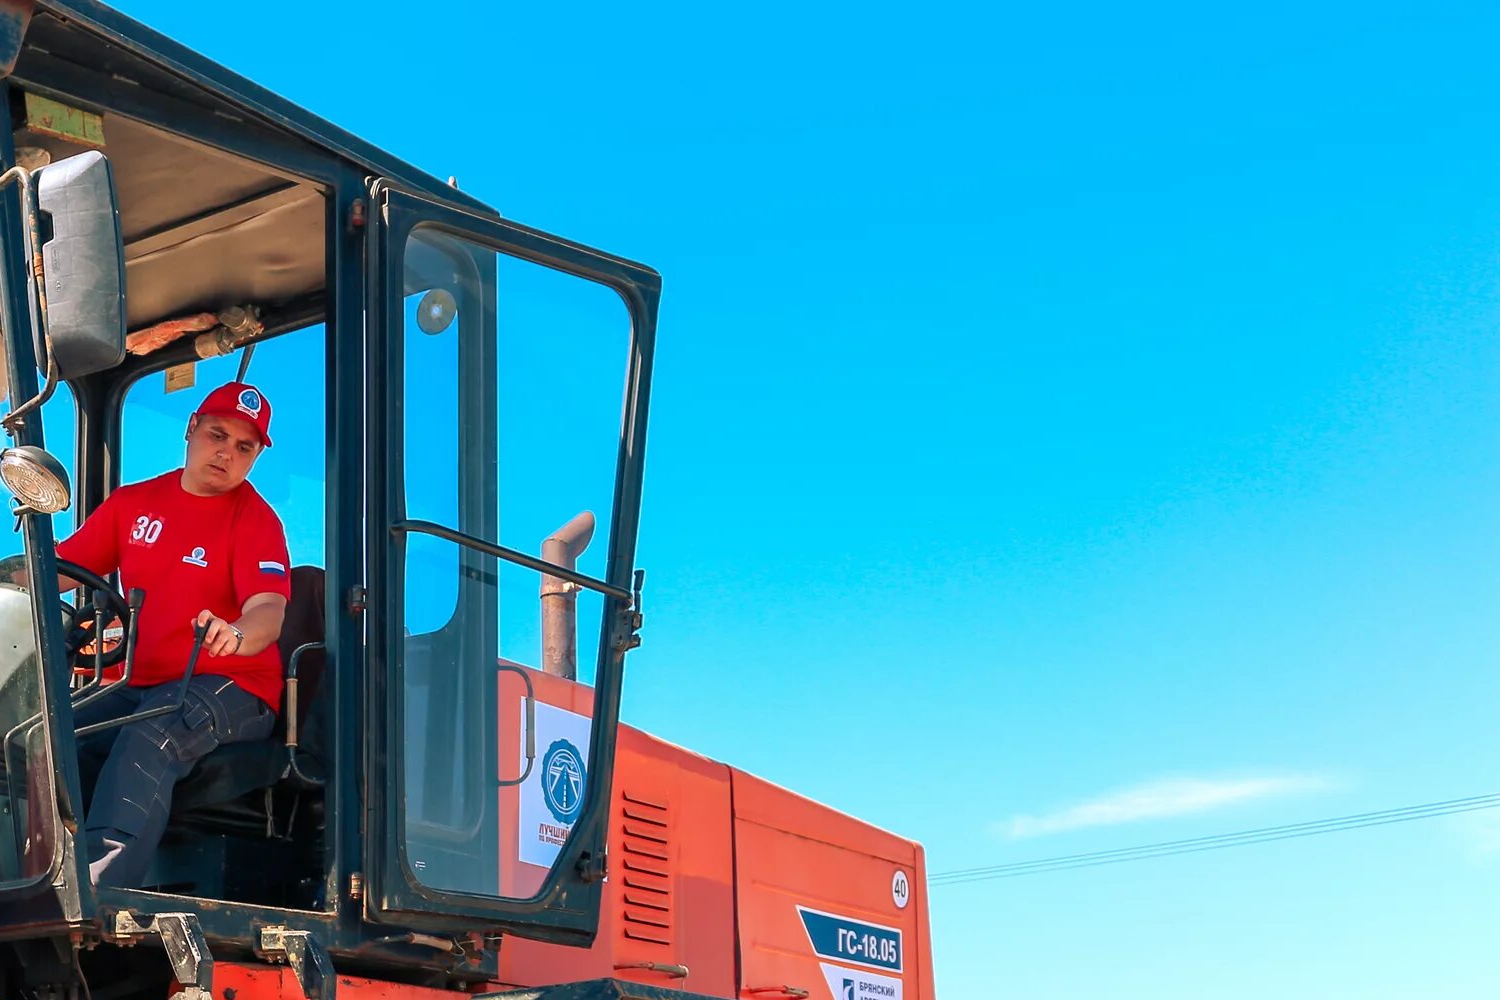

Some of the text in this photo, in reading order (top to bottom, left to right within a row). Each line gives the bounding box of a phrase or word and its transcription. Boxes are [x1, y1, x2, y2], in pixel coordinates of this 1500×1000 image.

[132, 515, 163, 544] 30
[894, 879, 906, 898] 40
[838, 928, 897, 964] ГС-18.05
[859, 980, 896, 997] БРЯНСКИЙ
